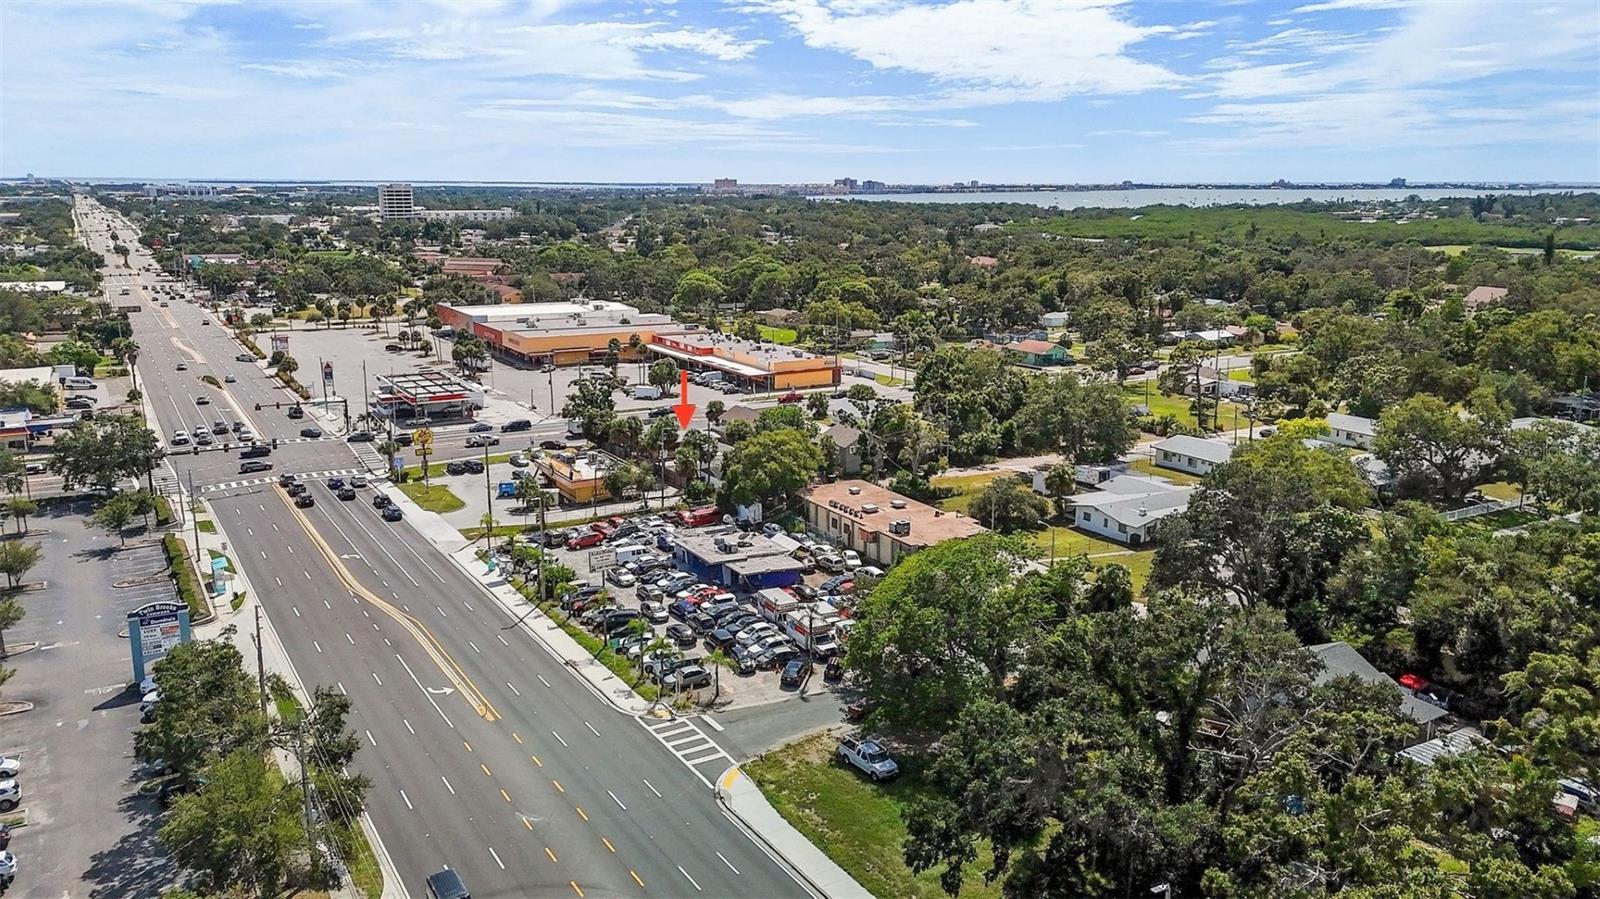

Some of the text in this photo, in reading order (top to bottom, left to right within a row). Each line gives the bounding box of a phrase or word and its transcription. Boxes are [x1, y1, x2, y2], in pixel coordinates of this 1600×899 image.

[139, 604, 177, 616] Twin Brooks
[150, 616, 176, 625] Domino's
